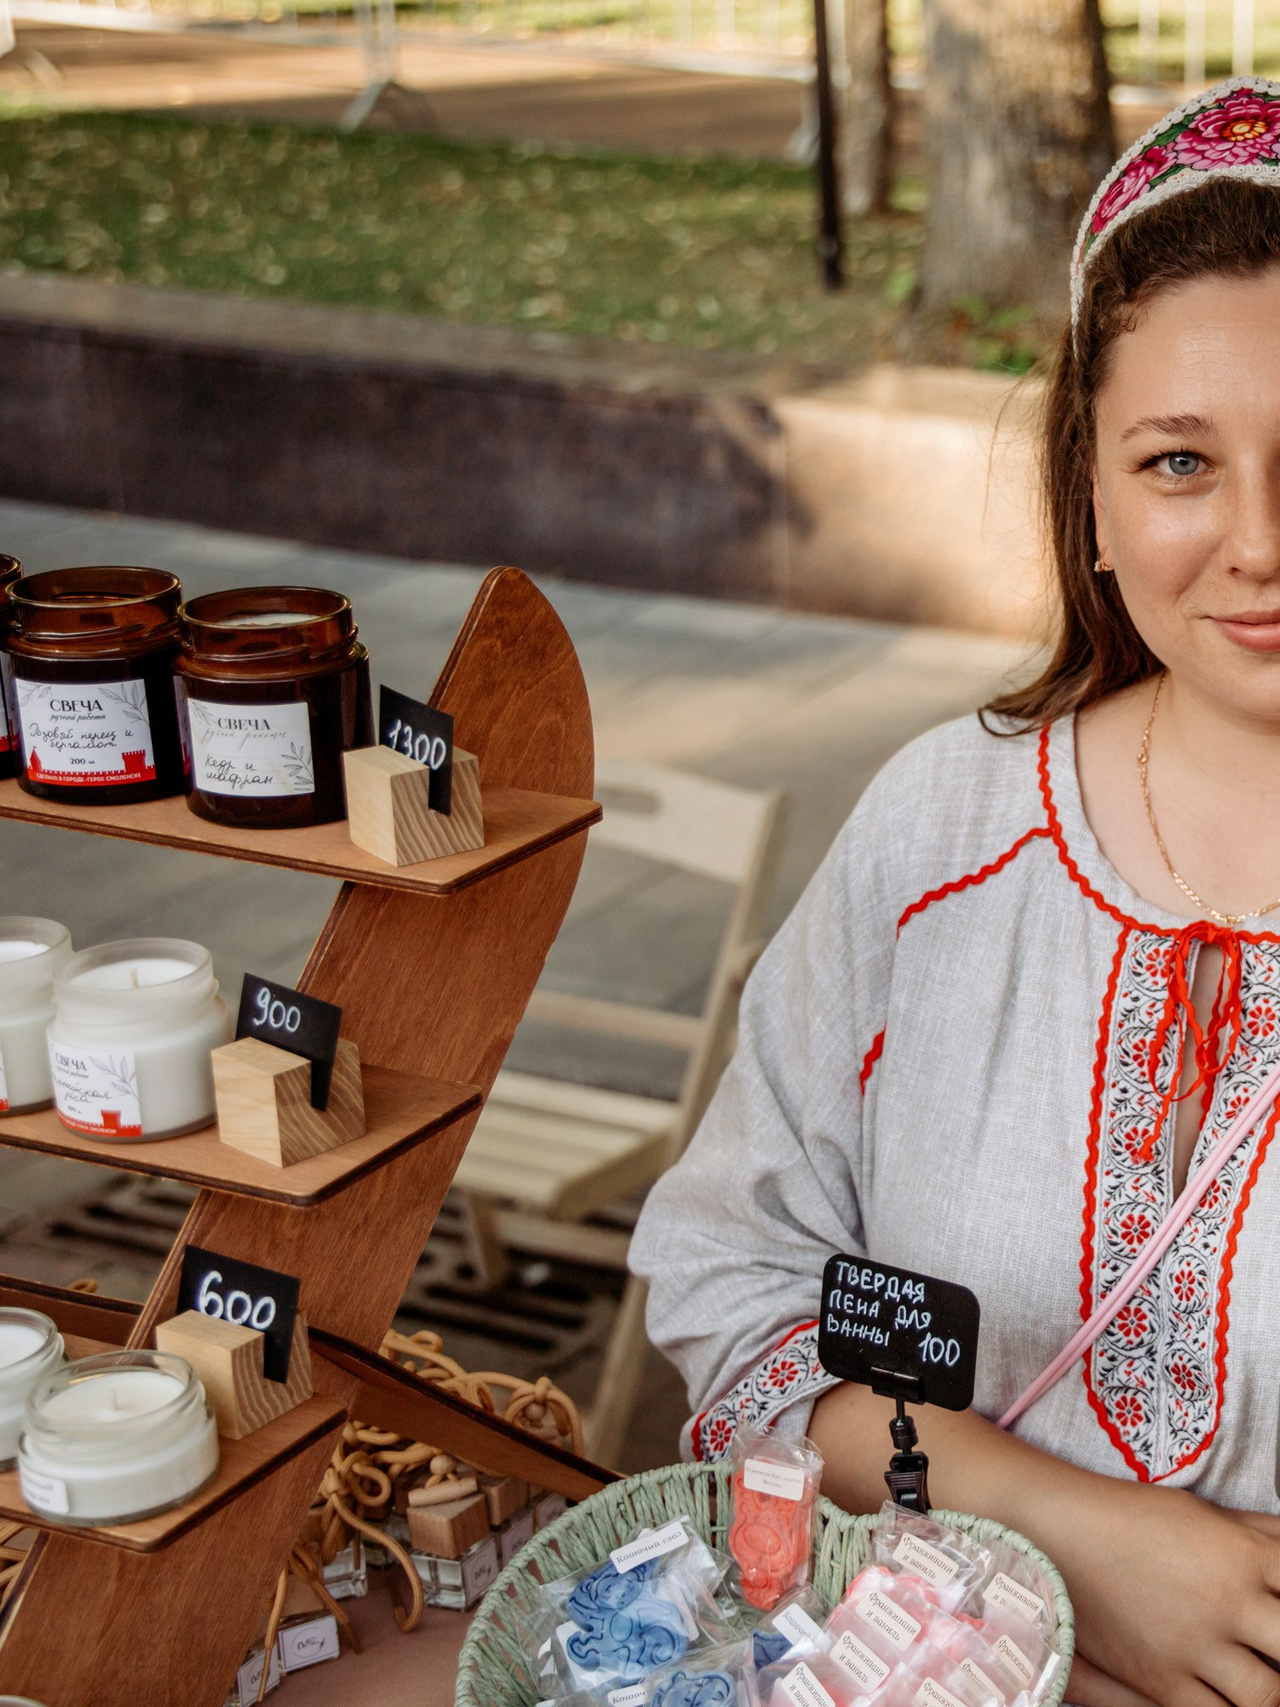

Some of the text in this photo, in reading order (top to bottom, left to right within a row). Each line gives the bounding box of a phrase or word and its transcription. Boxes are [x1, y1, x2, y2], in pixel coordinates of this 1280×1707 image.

[50, 700, 103, 712] СВЕЧА
[218, 717, 271, 731] СВЕЧА
[389, 718, 446, 771] 1300
[36, 773, 58, 782] СДЕЛАНО
[106, 772, 142, 782] СМОЛЕНСКЕ
[205, 754, 258, 772] Кедр и
[206, 772, 274, 790] шафран
[253, 987, 301, 1033] 900
[55, 1053, 87, 1072] СВЕЧА
[836, 1260, 926, 1304] ТВЕРДАЯ
[198, 1270, 276, 1330] 600
[829, 1289, 932, 1330] ПЕНА ДЛЯ
[827, 1313, 961, 1366] ВАННЫ 100
[616, 1531, 683, 1564] Кошачий глаз
[902, 1536, 954, 1574] Франжипани
[908, 1558, 936, 1580] ваниль
[994, 1576, 1040, 1612] Франжипани
[866, 1610, 900, 1642] и ваниль
[869, 1592, 917, 1636] Франжипани
[839, 1653, 869, 1684] и ваниль
[842, 1634, 886, 1678] Франжипани
[789, 1684, 796, 1692] и
